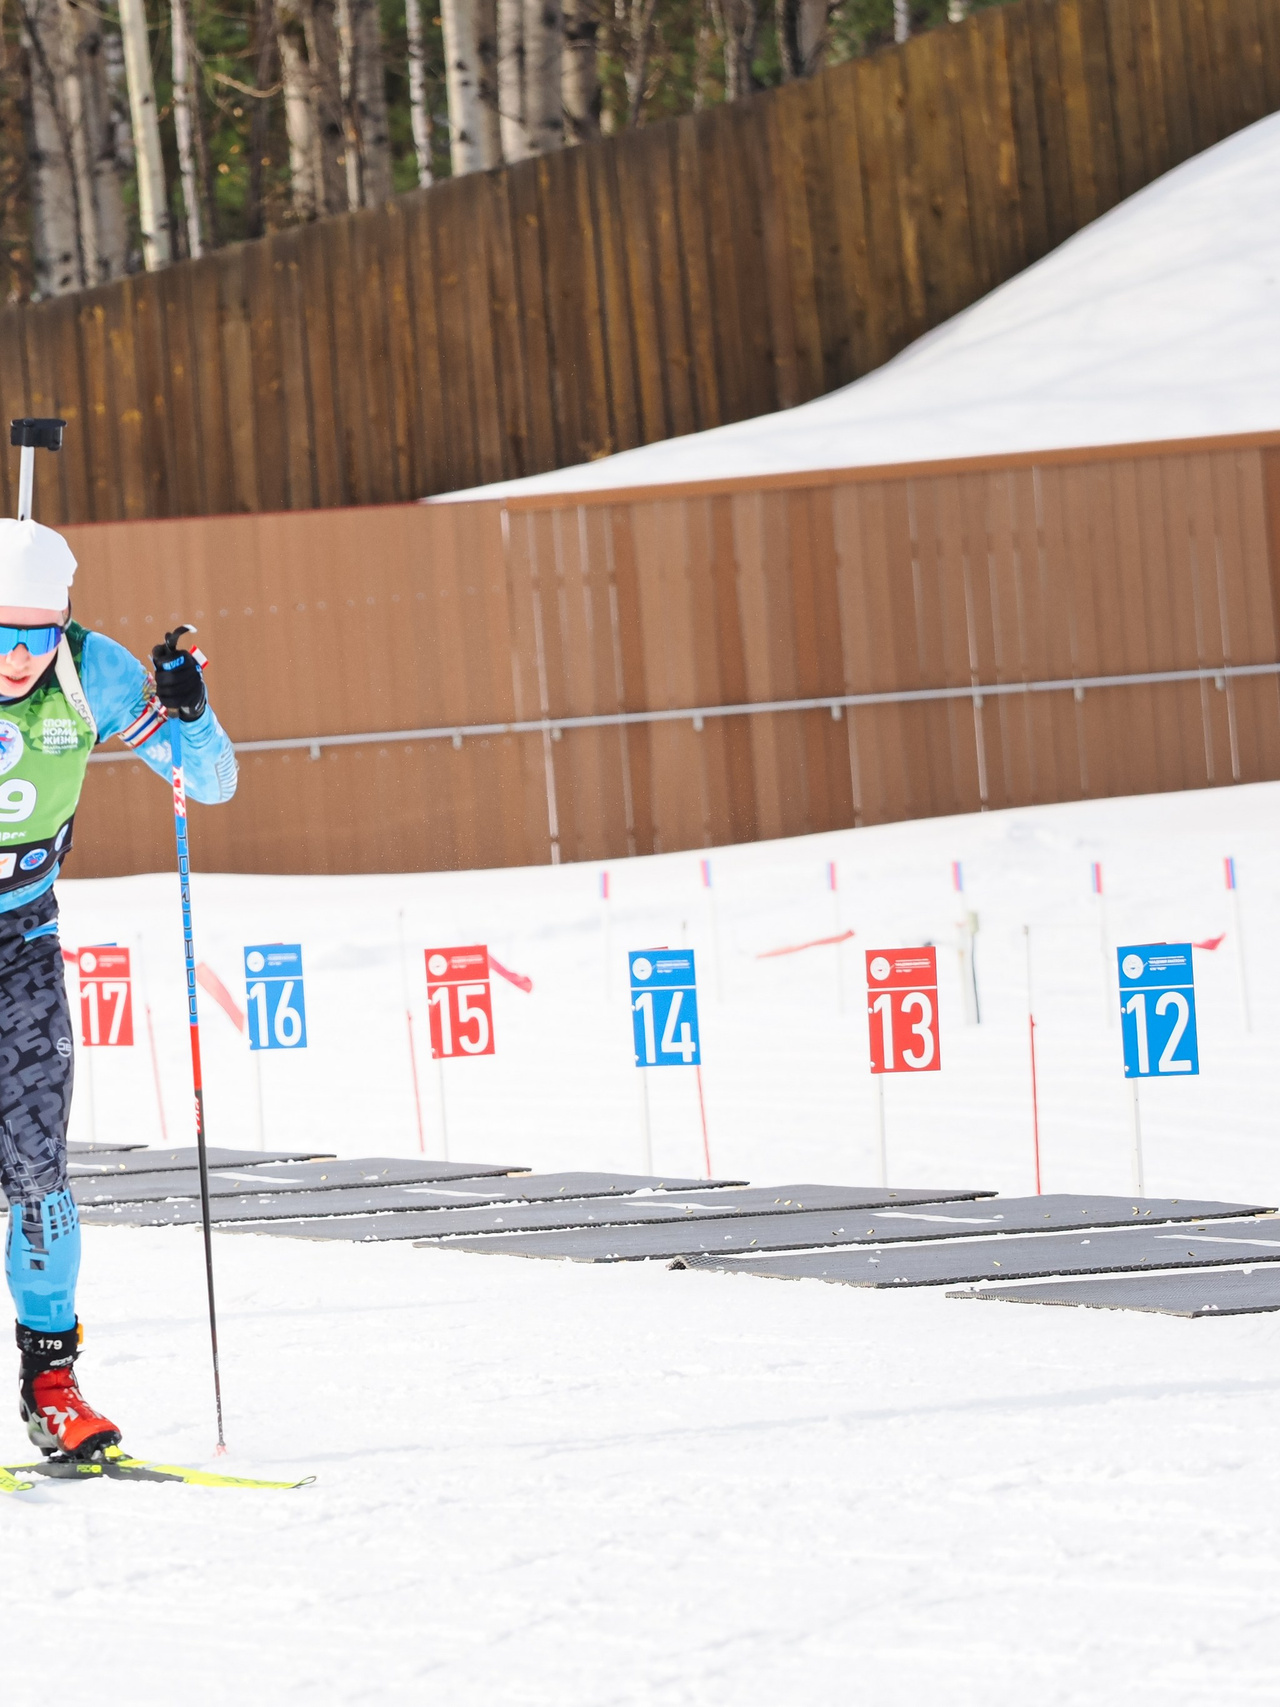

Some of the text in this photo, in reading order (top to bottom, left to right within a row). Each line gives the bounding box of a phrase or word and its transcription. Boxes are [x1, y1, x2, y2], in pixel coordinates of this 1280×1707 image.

[80, 982, 128, 1044] 17
[248, 982, 302, 1048] 16
[430, 984, 490, 1056] 15
[634, 991, 696, 1064] 14
[873, 992, 934, 1069] 13
[1126, 991, 1192, 1073] 12
[38, 1339, 63, 1350] 179
